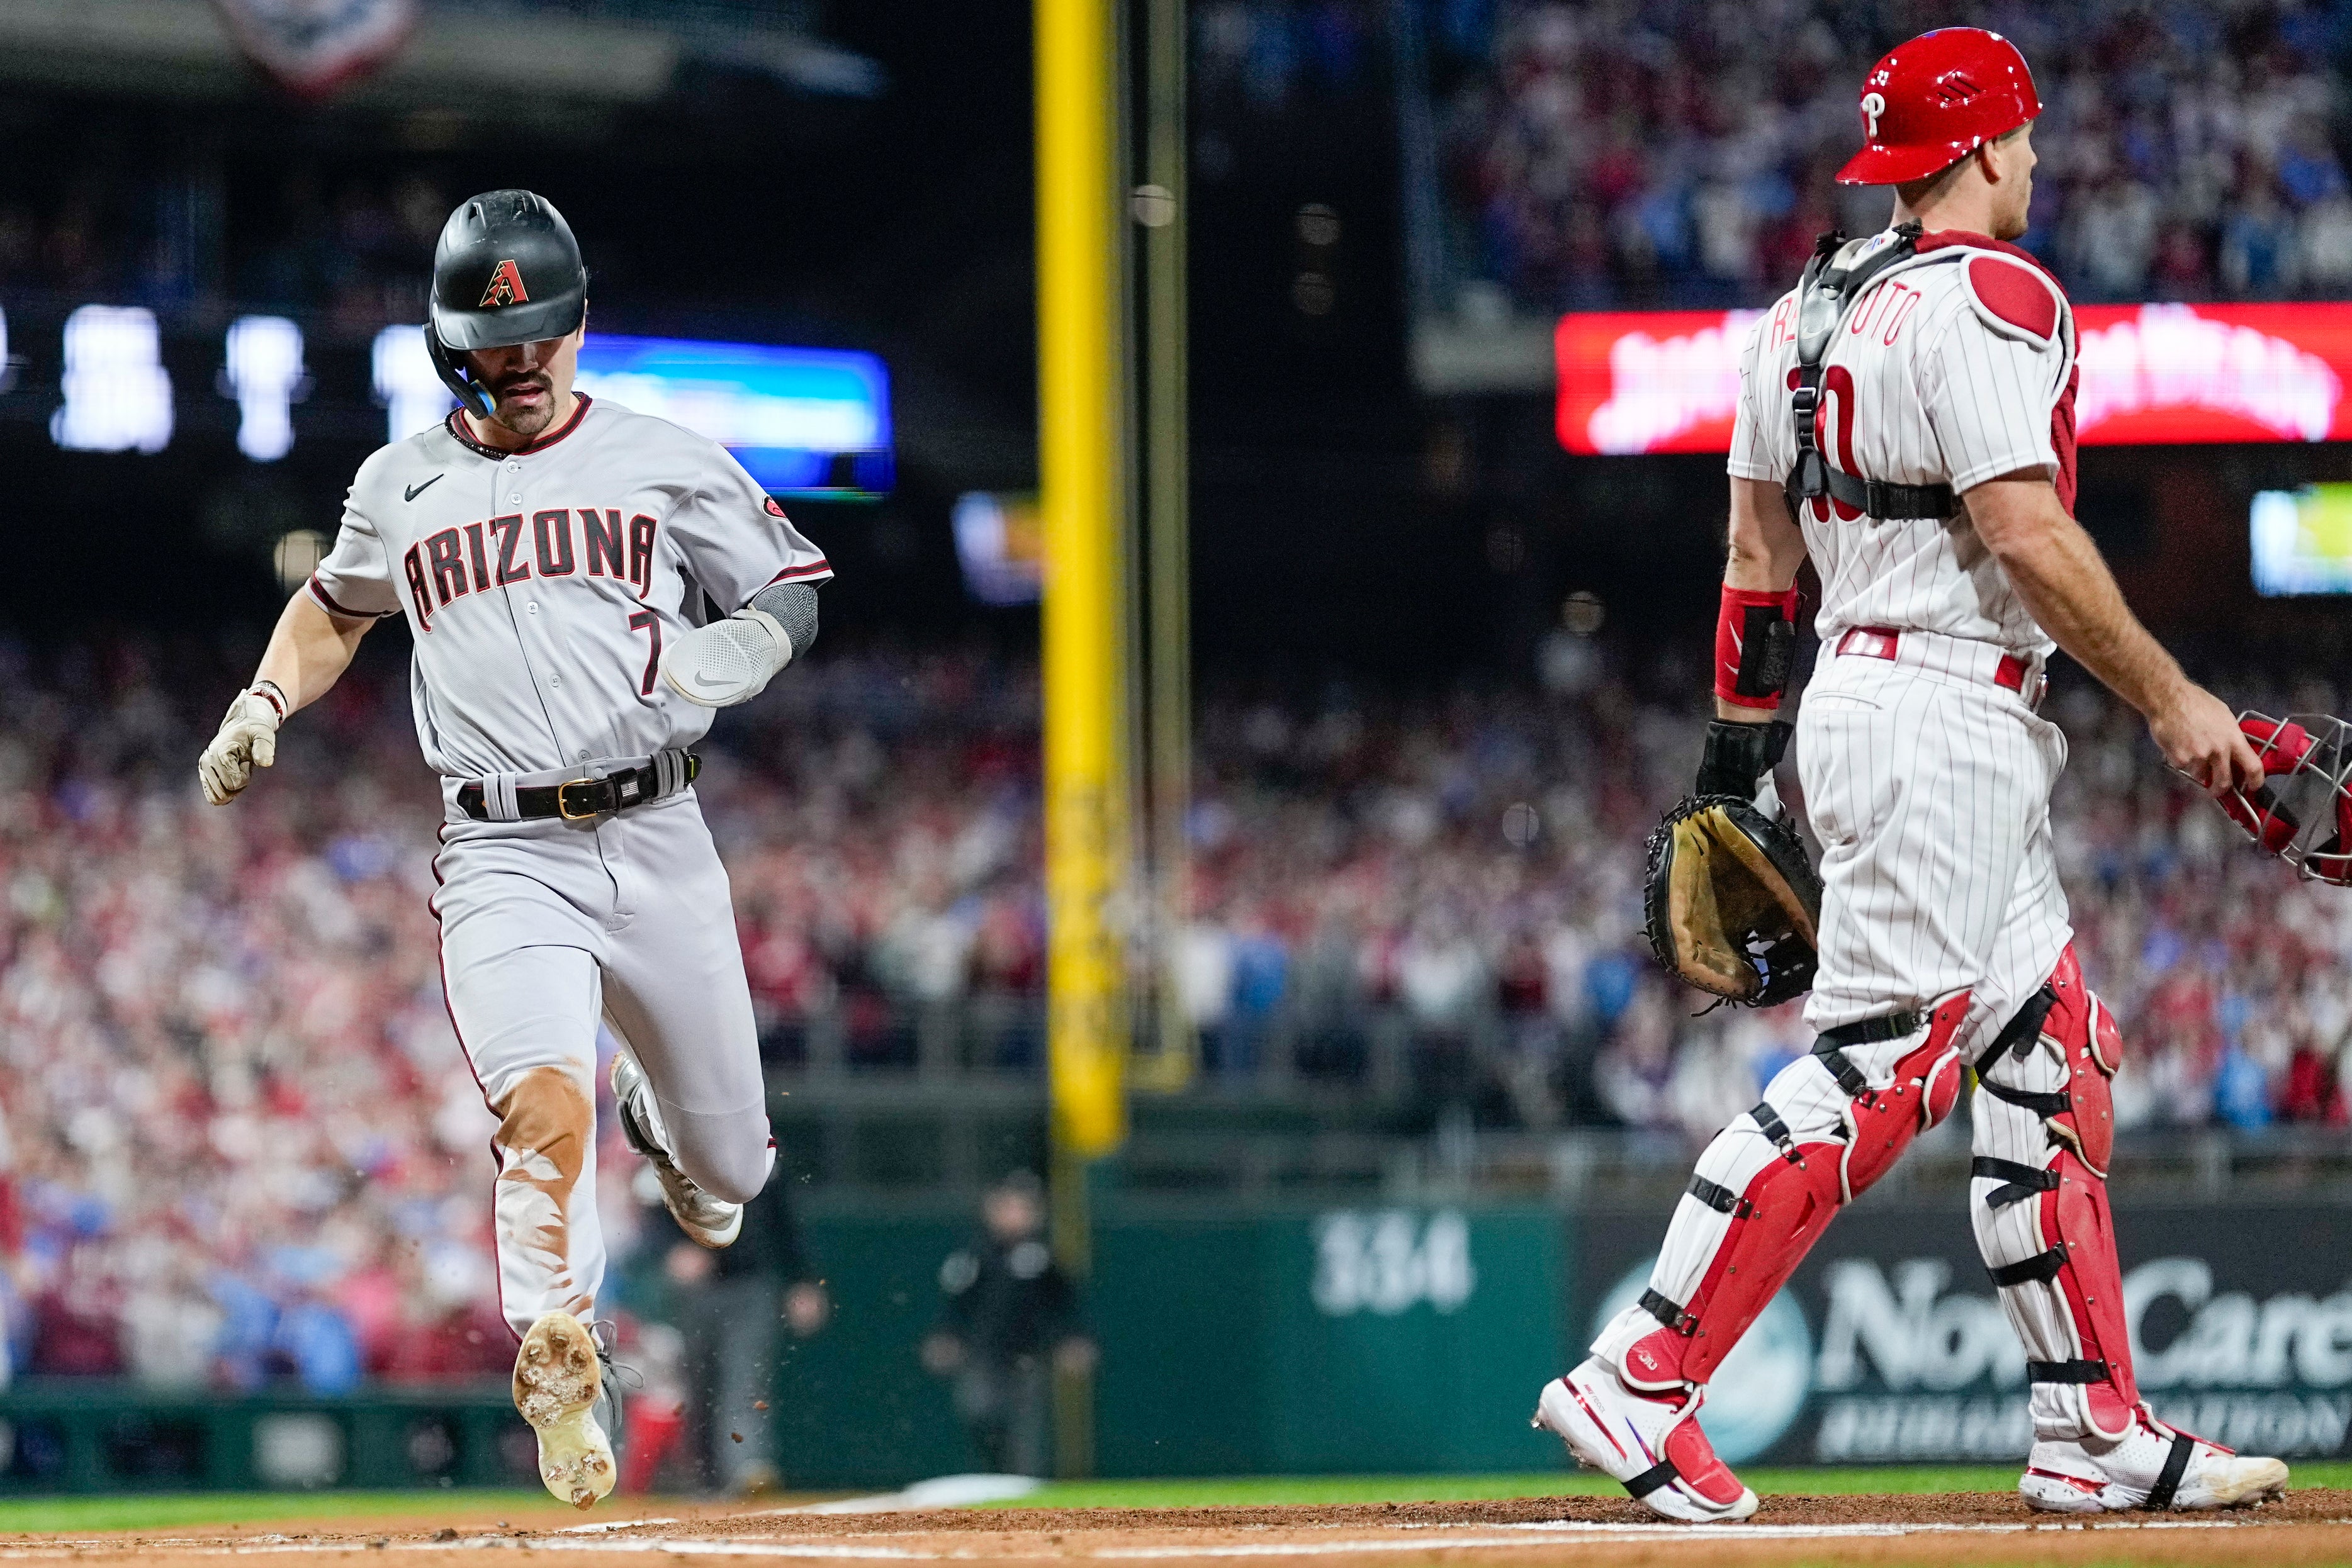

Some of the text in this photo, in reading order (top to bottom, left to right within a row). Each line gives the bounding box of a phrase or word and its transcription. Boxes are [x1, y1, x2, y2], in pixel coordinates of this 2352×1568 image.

[1861, 92, 1885, 137] P
[479, 259, 529, 307] A
[405, 508, 658, 634] ARIZONA
[628, 608, 660, 696] 7
[1313, 1208, 1477, 1315] 334
